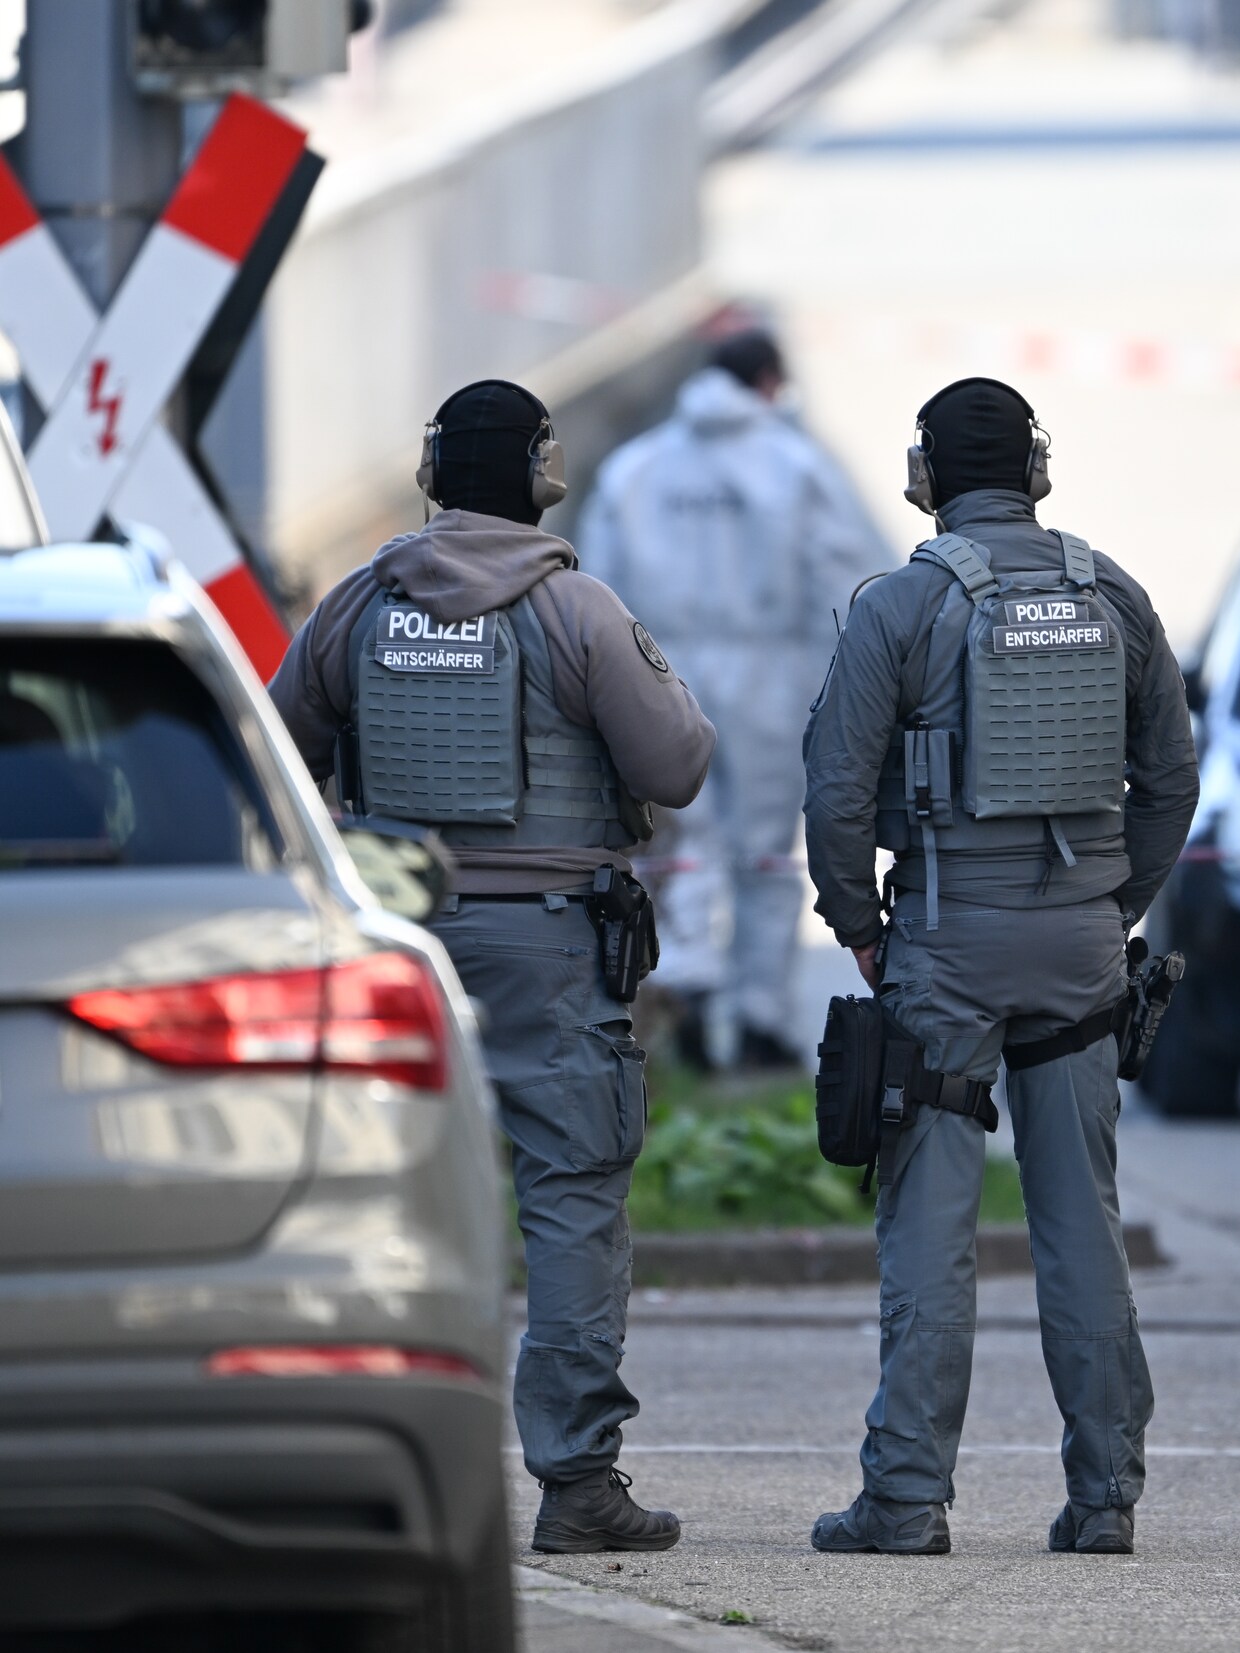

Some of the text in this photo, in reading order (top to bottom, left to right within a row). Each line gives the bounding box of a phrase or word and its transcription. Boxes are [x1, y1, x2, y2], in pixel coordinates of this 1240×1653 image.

[1016, 603, 1076, 621] POLIZEI
[1005, 626, 1102, 646] ENTSCHÄRFER
[384, 649, 483, 668] ENTSCHÄRFER
